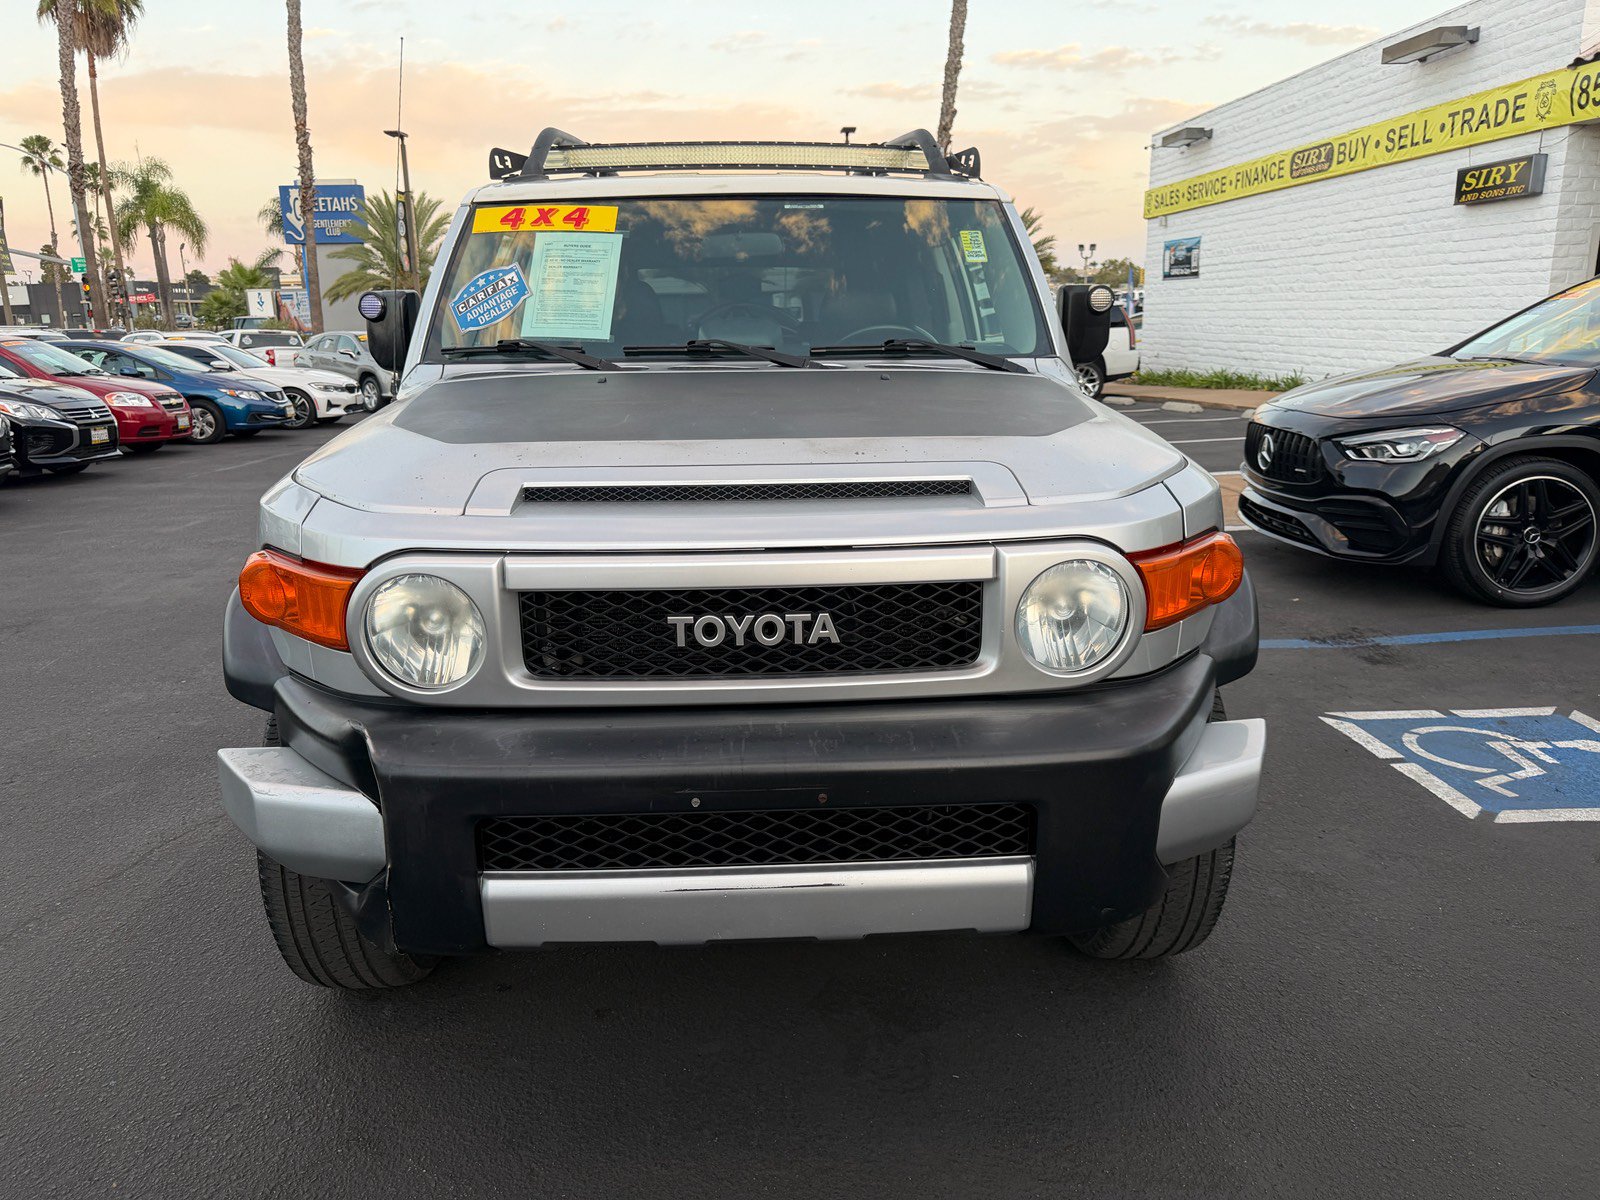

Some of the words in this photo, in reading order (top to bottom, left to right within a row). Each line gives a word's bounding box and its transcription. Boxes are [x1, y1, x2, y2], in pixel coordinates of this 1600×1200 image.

[1336, 134, 1371, 166] BUY
[1384, 119, 1433, 154] SELL
[1448, 92, 1528, 139] TRADE
[1291, 144, 1332, 170] SIRY
[1154, 189, 1180, 209] SALES
[1186, 176, 1227, 202] SERVICE
[1234, 159, 1286, 190] FINANCE
[1460, 160, 1528, 192] SIRY
[313, 196, 359, 212] EETAHS
[1459, 192, 1479, 203] AND
[1479, 187, 1506, 199] SONS
[1505, 184, 1526, 195] INC
[325, 228, 342, 236] CLUB
[456, 274, 518, 313] CARFAX
[466, 286, 519, 322] ADVANTAGE
[477, 299, 514, 325] DEALER
[667, 612, 841, 648] TOYOTA
